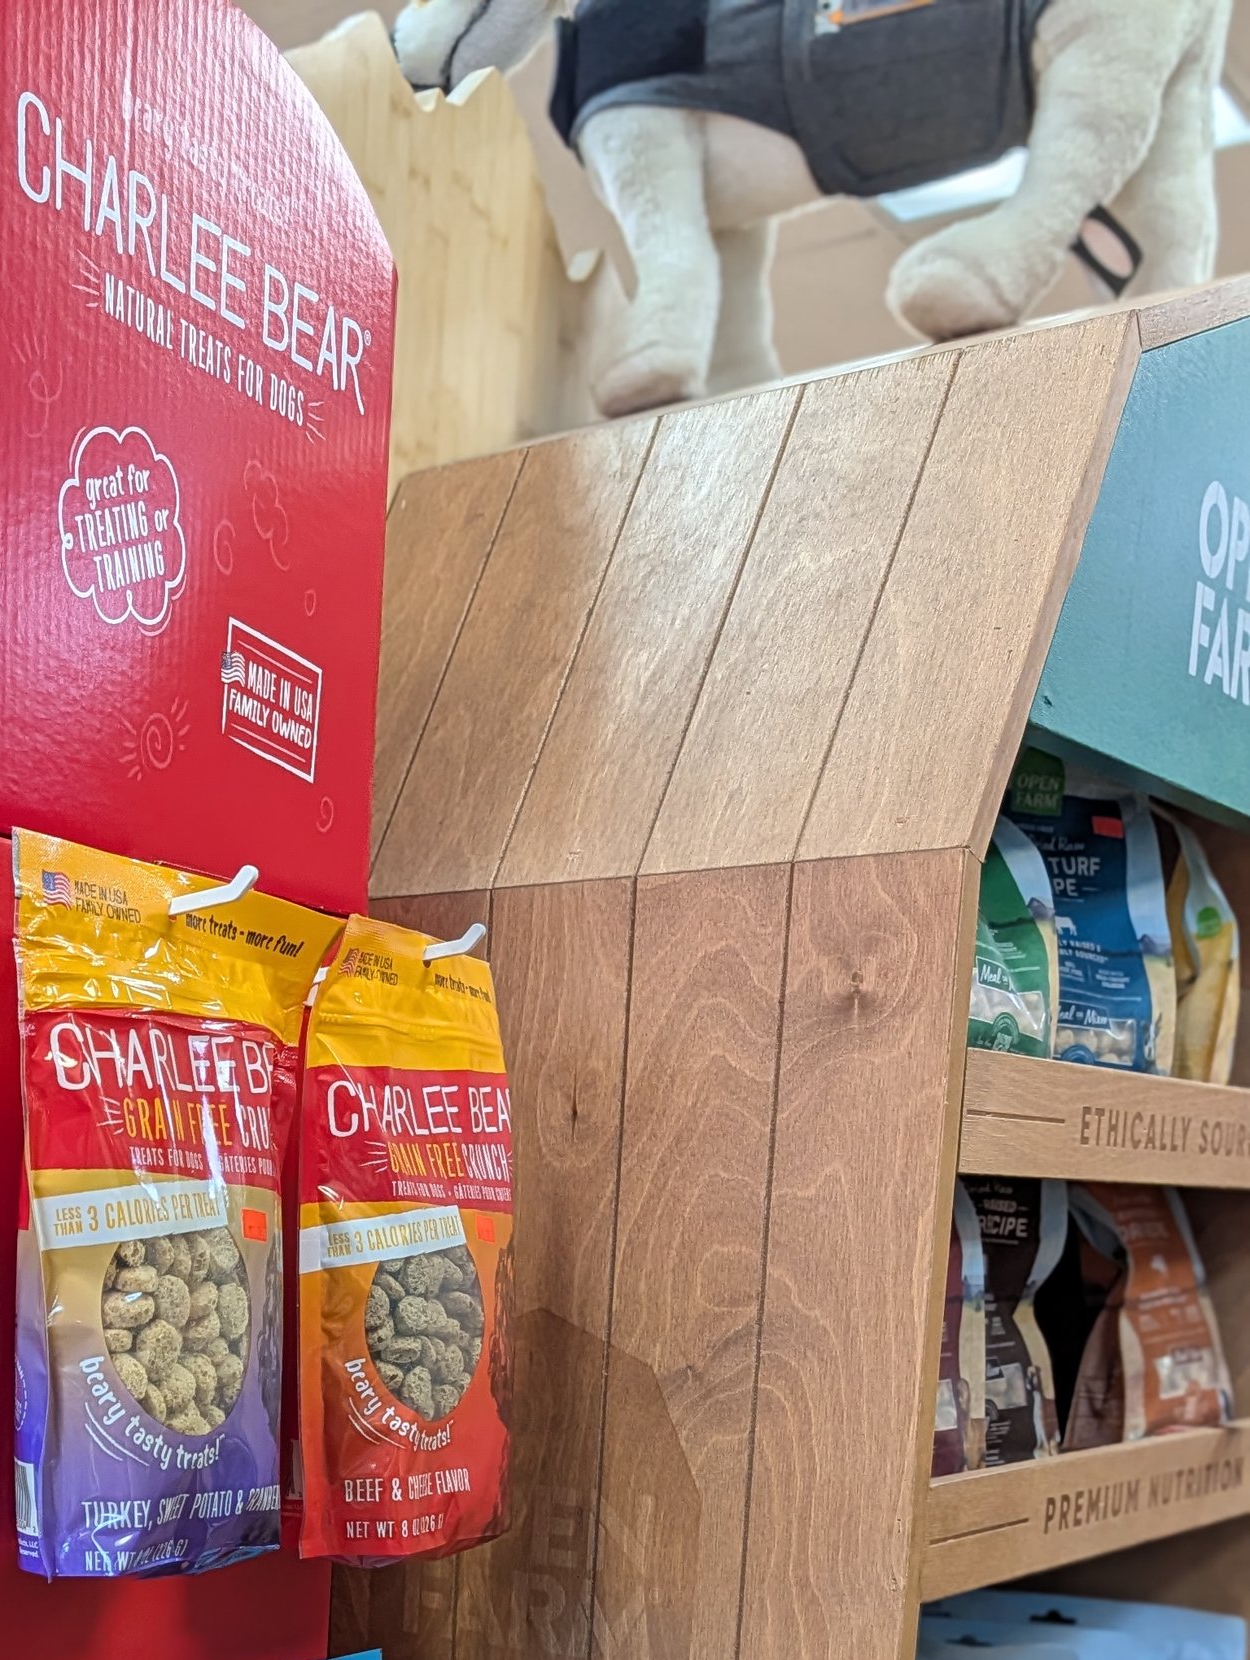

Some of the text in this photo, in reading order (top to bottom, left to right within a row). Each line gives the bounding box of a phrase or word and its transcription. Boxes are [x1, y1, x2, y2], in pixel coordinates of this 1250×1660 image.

[17, 91, 251, 329] CHARLEE
[104, 273, 305, 427] NATURAL TREATS FOR DOGS
[85, 464, 150, 508] great for
[75, 501, 169, 552] TREATING or
[93, 540, 165, 592] TRAINING
[229, 689, 312, 749] FAMILY OWNED
[248, 661, 313, 723] MADE IN USA
[185, 913, 304, 957] more treats more fun!
[327, 1081, 463, 1138] CHARLEE
[1079, 1106, 1191, 1153] ETHICALLY
[389, 1140, 509, 1182] GRAIN FREE CRUNCH
[78, 1355, 173, 1470] beary tasty
[1044, 1458, 1245, 1534] PREMIUM NUTRITION
